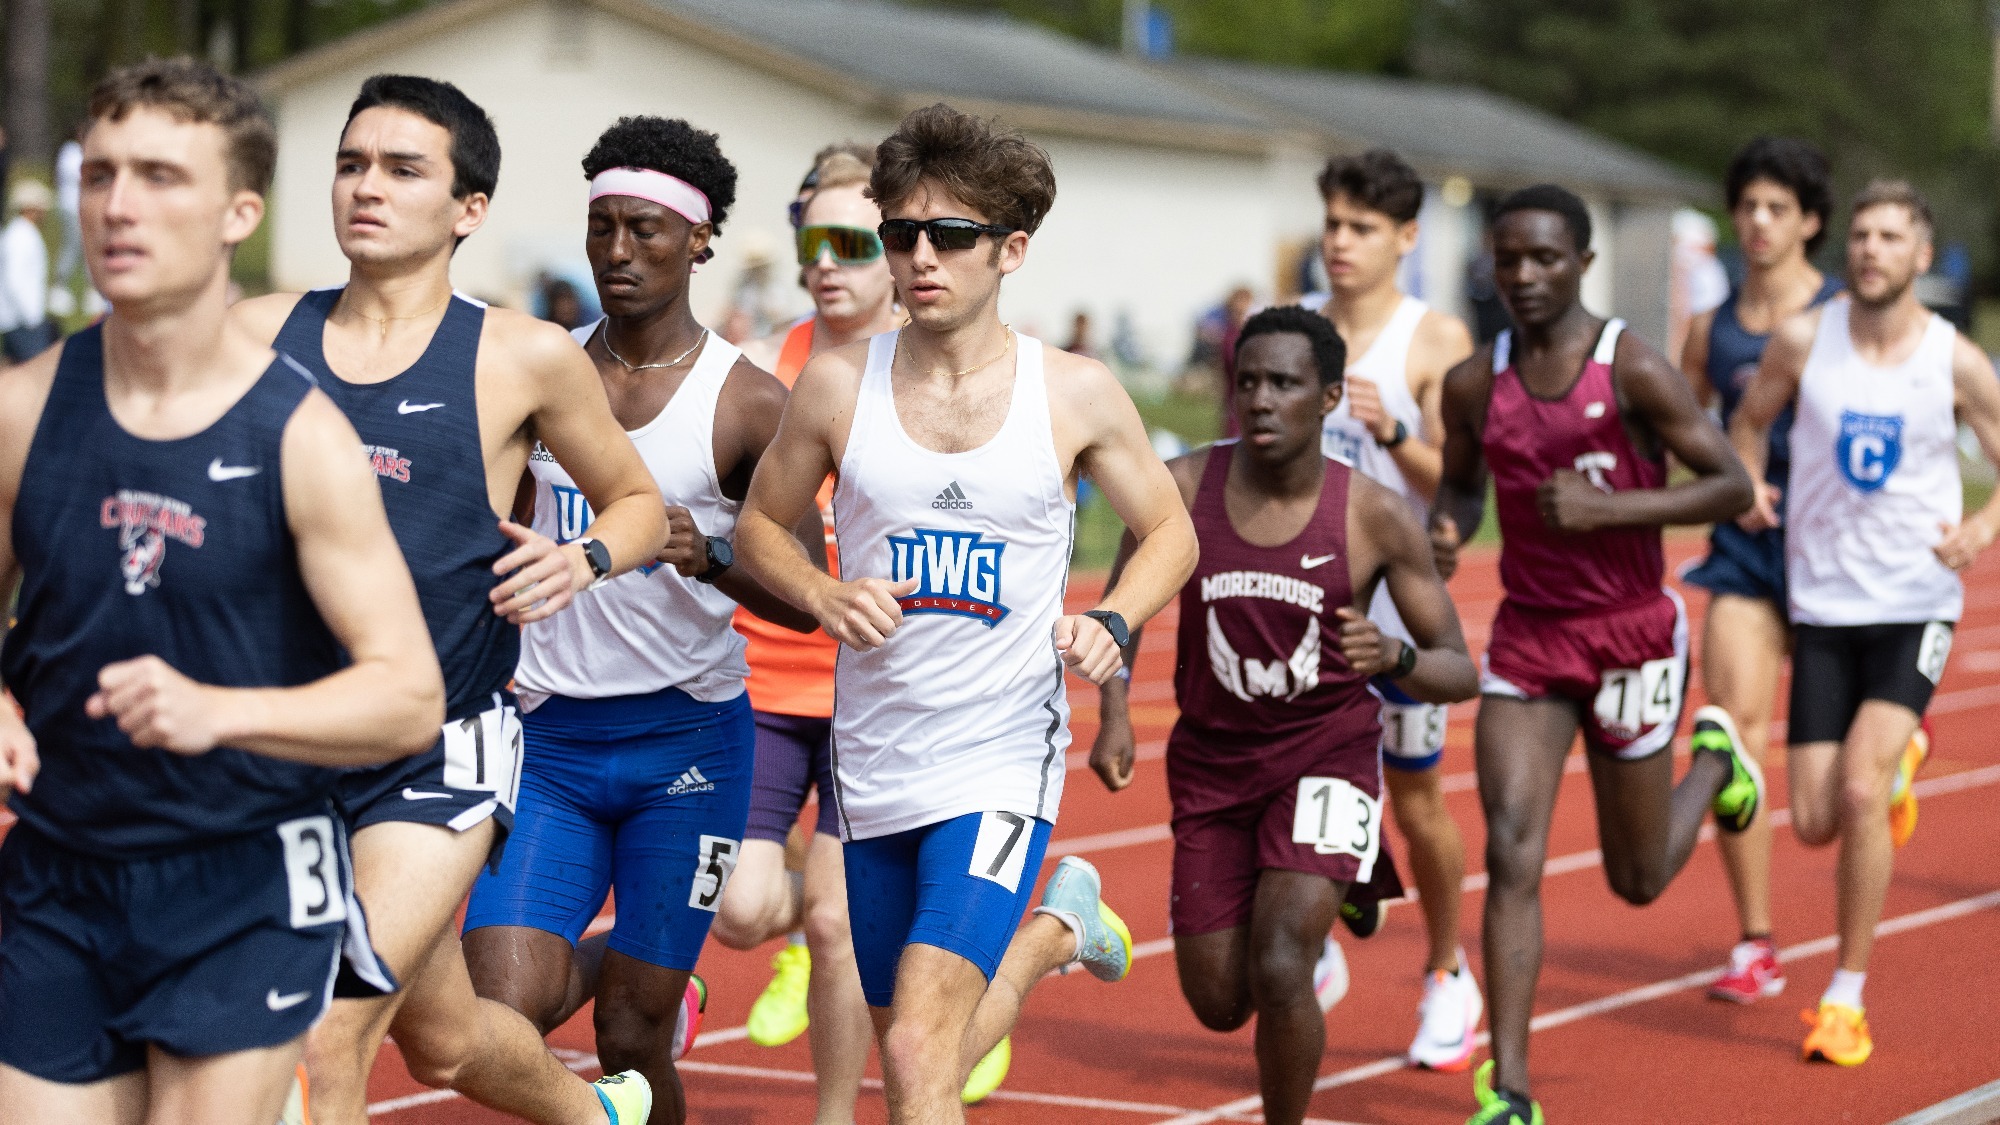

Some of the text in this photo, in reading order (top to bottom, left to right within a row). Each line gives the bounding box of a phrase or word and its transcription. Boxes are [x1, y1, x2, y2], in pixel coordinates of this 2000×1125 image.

[1573, 451, 1617, 494] T
[1848, 436, 1886, 481] C
[931, 499, 974, 510] adidas
[894, 534, 996, 603] UWG
[900, 600, 994, 615] OLVES
[1201, 571, 1325, 614] MOREHOUSE
[1243, 657, 1290, 697] M
[1611, 666, 1671, 720] 14
[667, 782, 715, 795] adidas
[1312, 785, 1370, 852] 13
[986, 811, 1025, 877] 7
[300, 828, 330, 916] 3
[699, 842, 732, 907] 5
